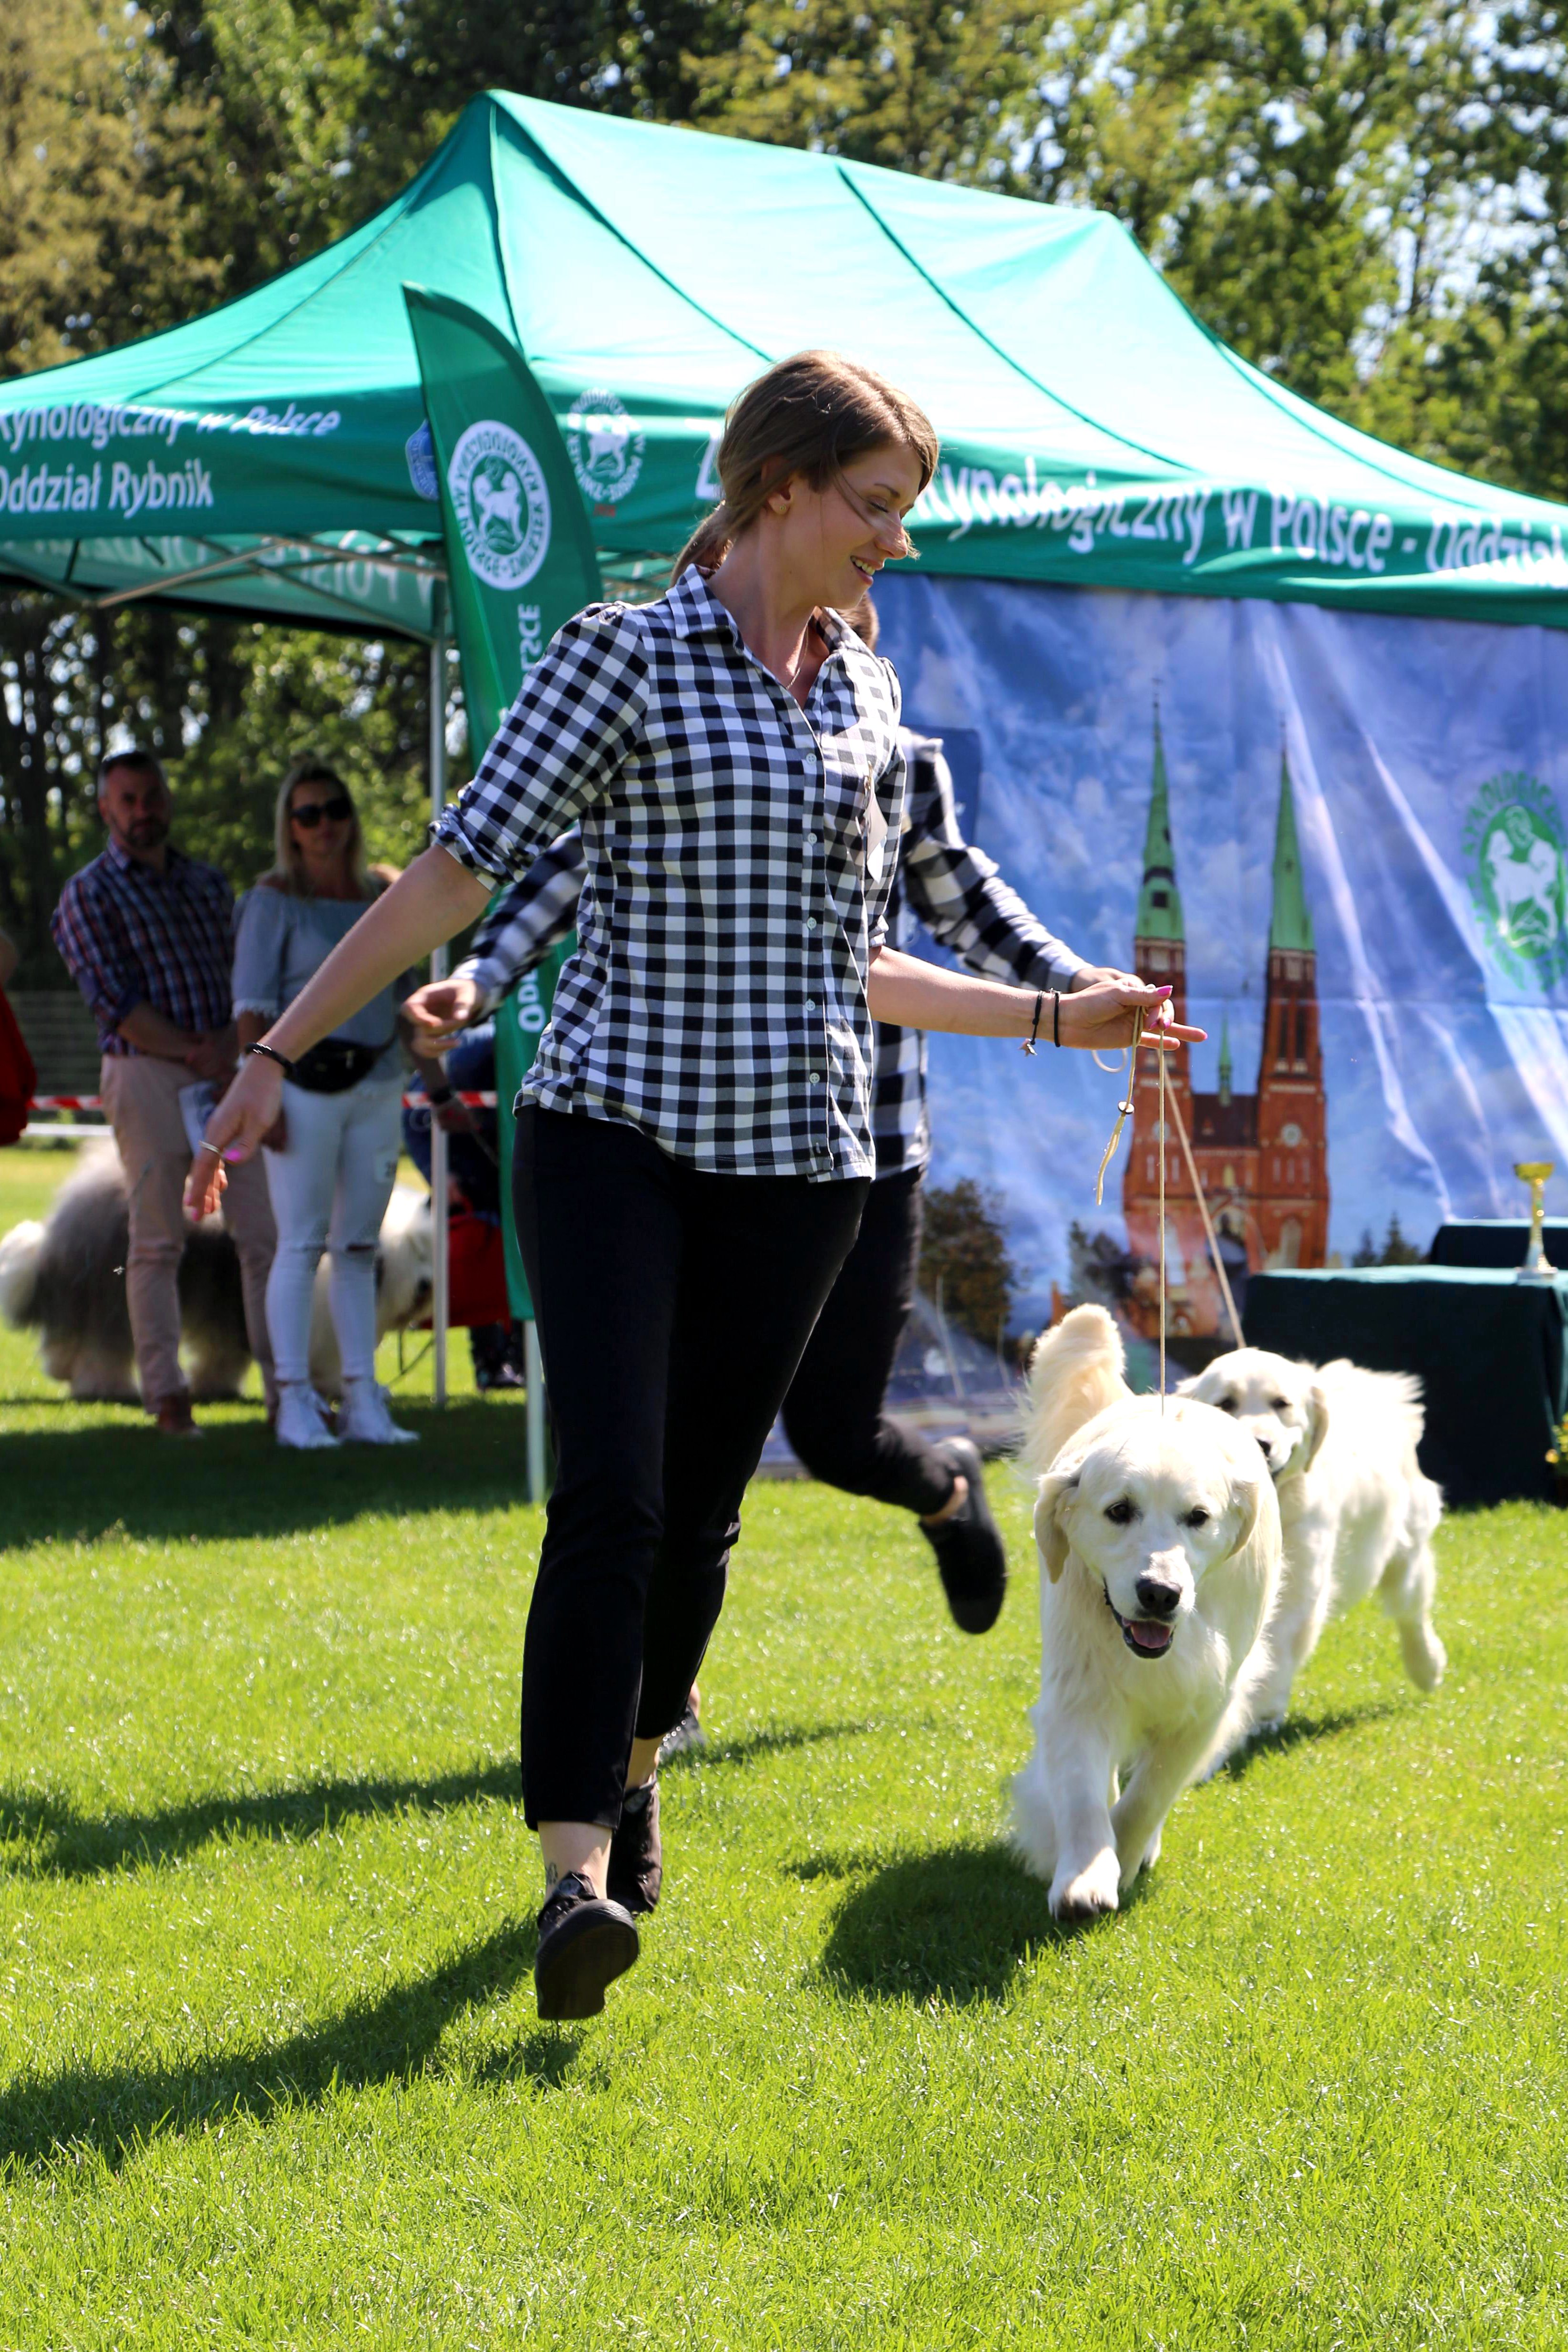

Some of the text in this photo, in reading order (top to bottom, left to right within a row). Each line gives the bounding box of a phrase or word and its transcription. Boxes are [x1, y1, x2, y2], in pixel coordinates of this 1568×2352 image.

[228, 402, 340, 436] Polsce
[108, 458, 214, 519] Rybnik
[1267, 482, 1393, 573] Polsce
